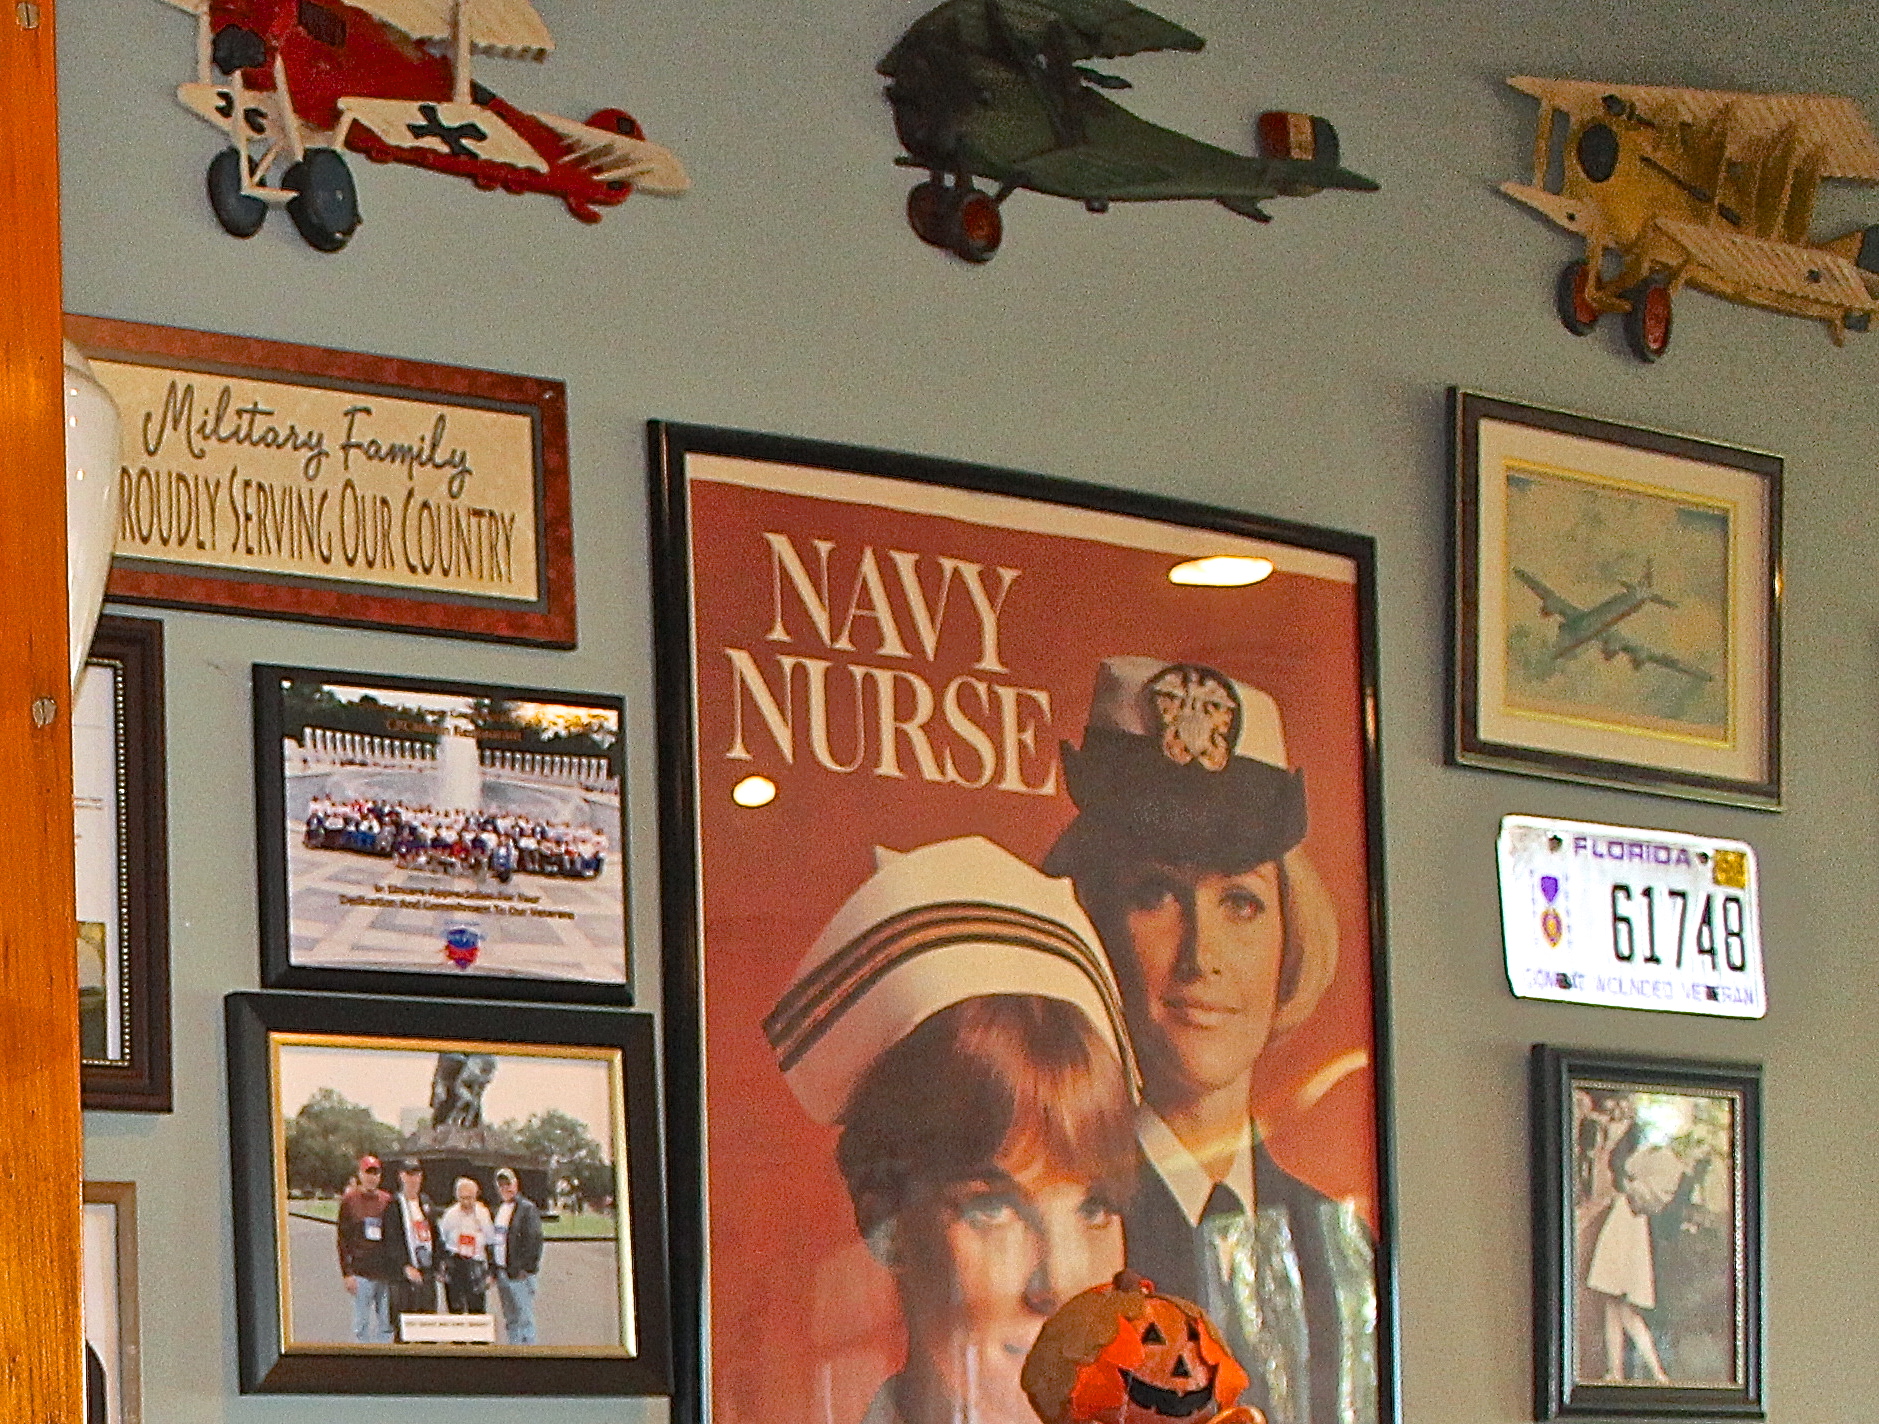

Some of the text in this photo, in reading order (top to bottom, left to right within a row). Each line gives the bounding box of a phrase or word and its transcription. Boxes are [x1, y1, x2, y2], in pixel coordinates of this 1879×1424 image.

[142, 380, 473, 498] Military Family
[119, 464, 516, 584] ROUDLY SERVING OUR COUNTRY
[763, 531, 1022, 674] NAVY
[724, 646, 1058, 796] NURSE
[1573, 837, 1692, 867] FLORIDA
[1611, 883, 1746, 973] 61748
